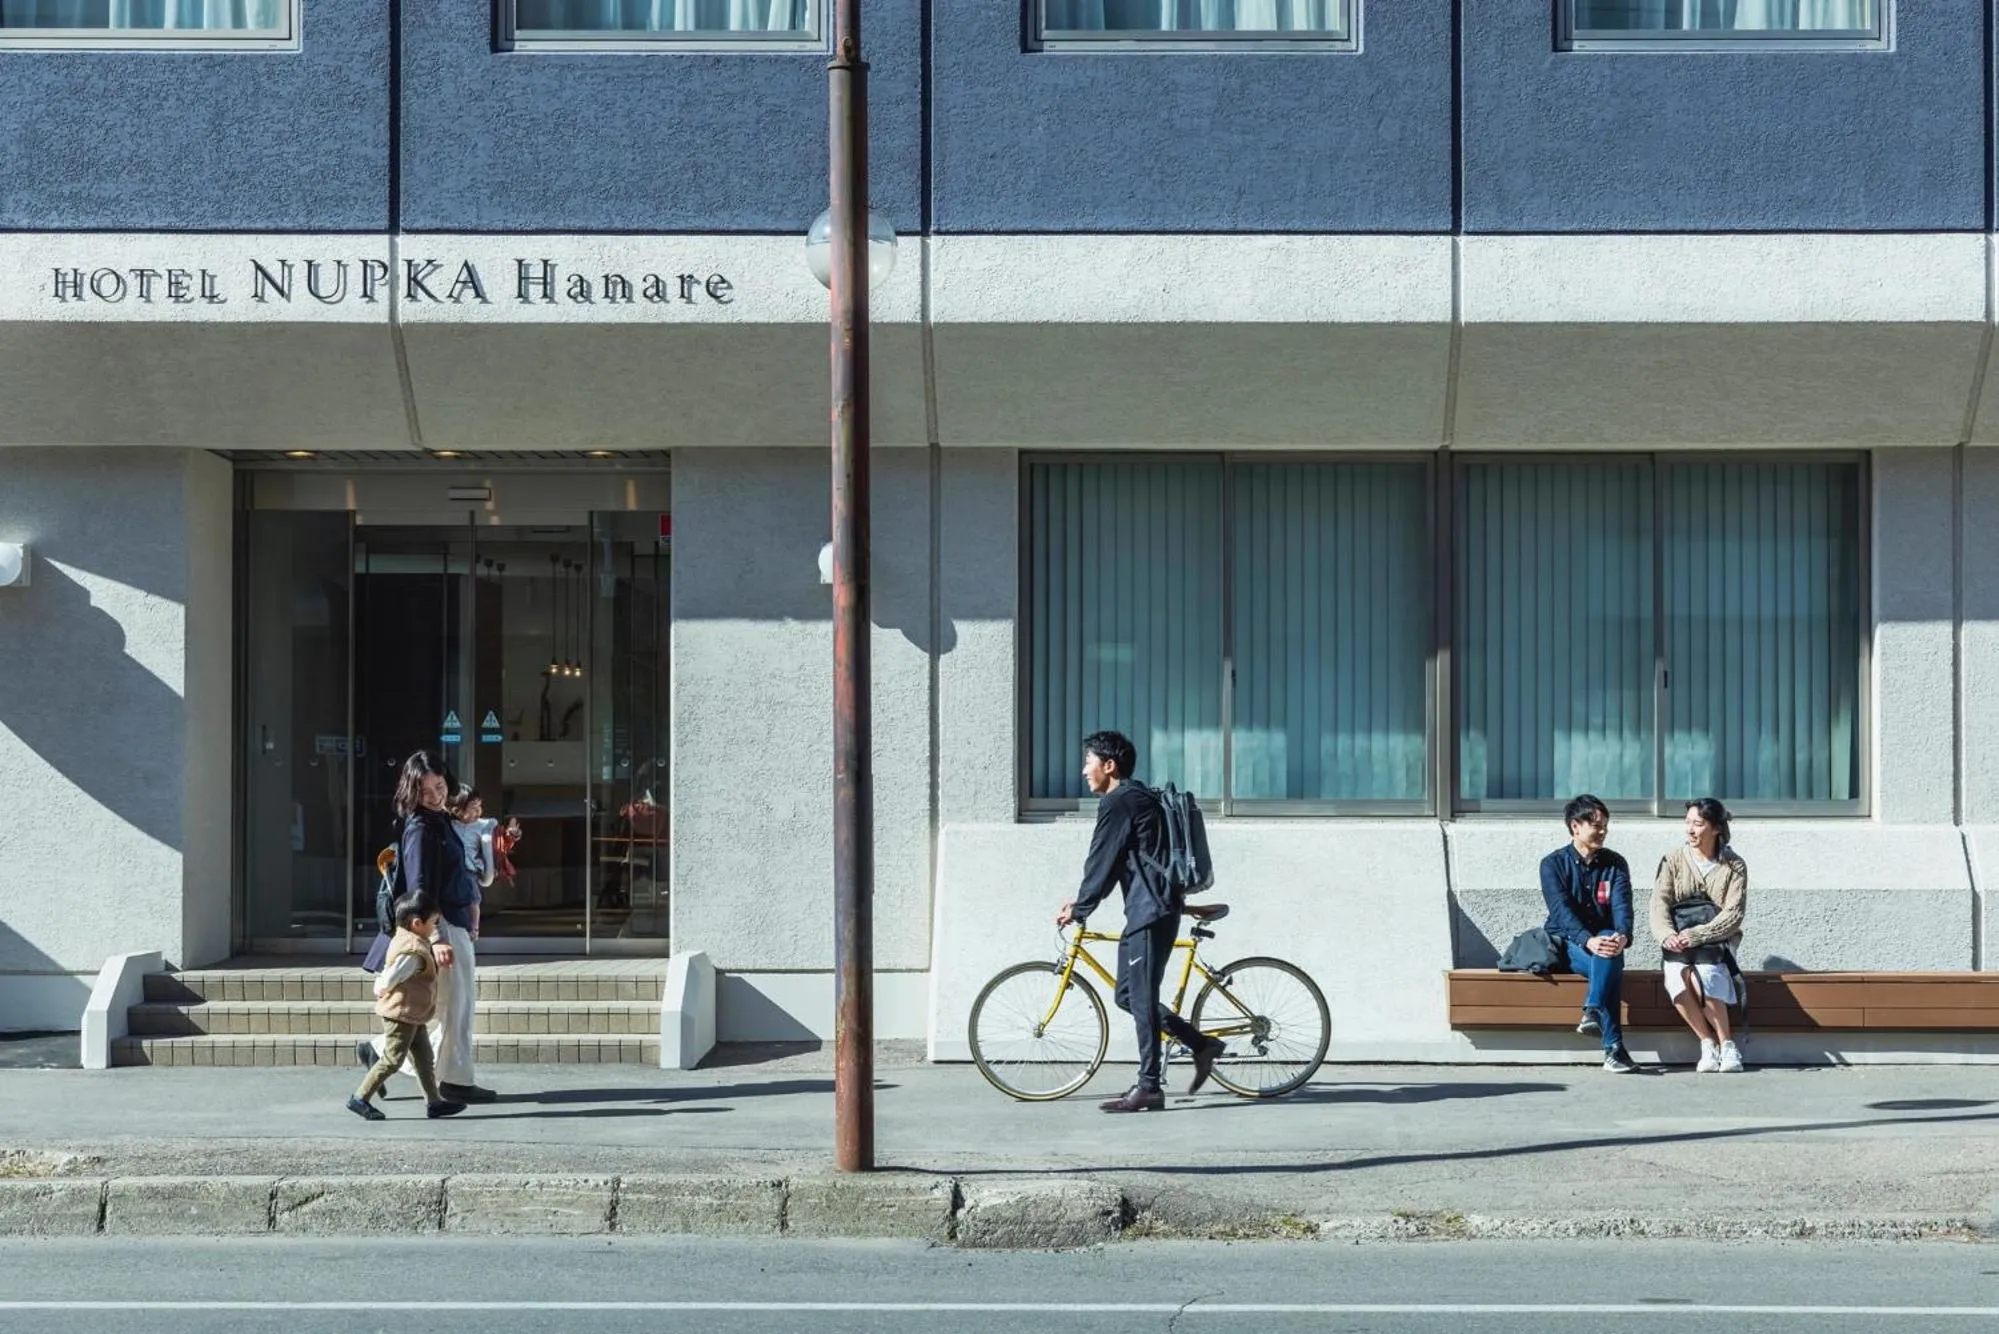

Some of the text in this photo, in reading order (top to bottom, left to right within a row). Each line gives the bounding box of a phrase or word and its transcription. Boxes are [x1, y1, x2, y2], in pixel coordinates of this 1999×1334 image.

[52, 258, 728, 300] HOTEL NUPKA Hanare
